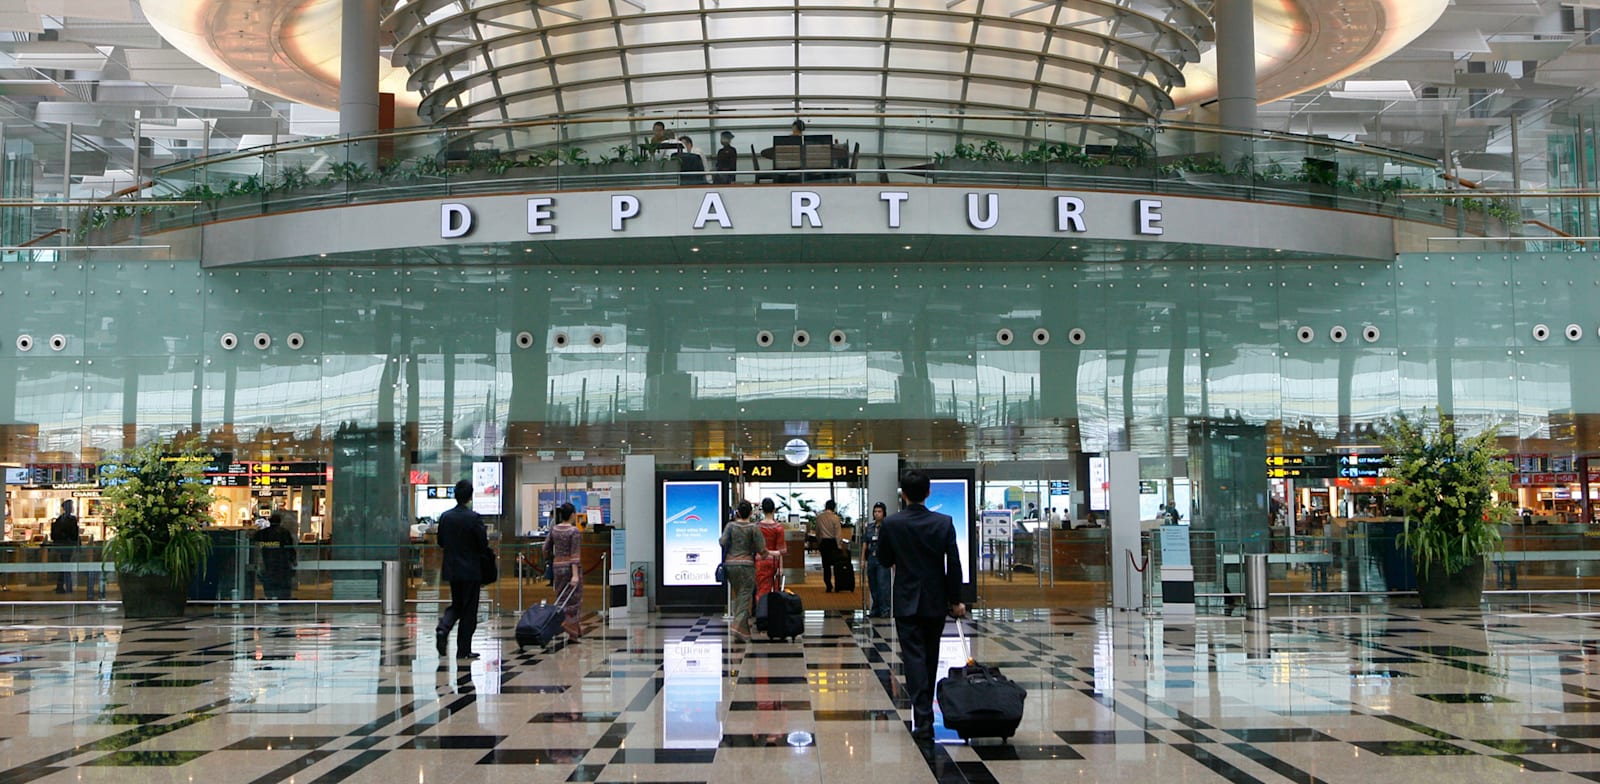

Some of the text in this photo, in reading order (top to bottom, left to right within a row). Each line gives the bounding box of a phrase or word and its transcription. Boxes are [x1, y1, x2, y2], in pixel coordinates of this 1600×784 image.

[440, 191, 1164, 240] DEPARTURE
[728, 466, 740, 476] A1
[751, 466, 772, 476] A21
[835, 466, 847, 476] B1
[674, 570, 711, 581] citibank
